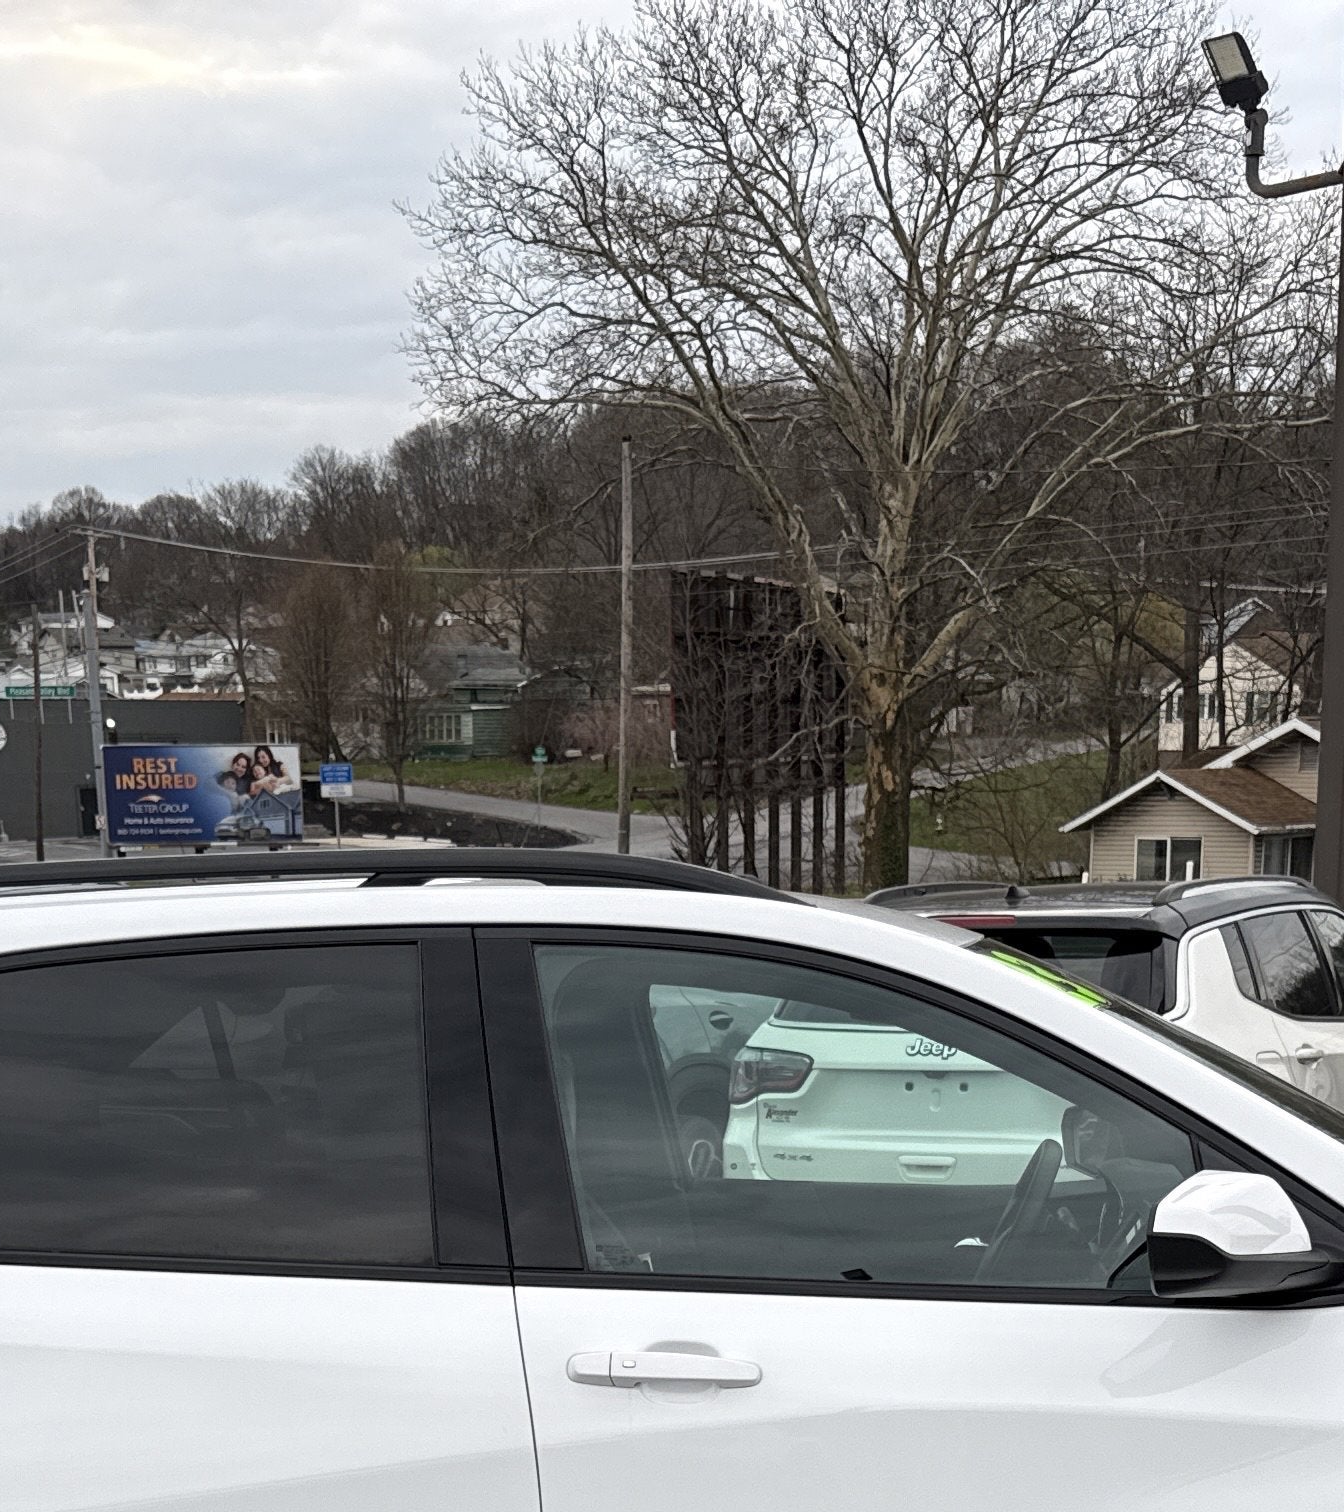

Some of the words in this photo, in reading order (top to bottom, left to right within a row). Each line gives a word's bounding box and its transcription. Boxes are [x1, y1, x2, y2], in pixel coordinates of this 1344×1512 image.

[132, 758, 177, 774] REST
[115, 774, 197, 790] INSURED
[159, 803, 189, 814] GROUP
[165, 817, 194, 825] Insurance
[906, 1038, 957, 1060] Jeep
